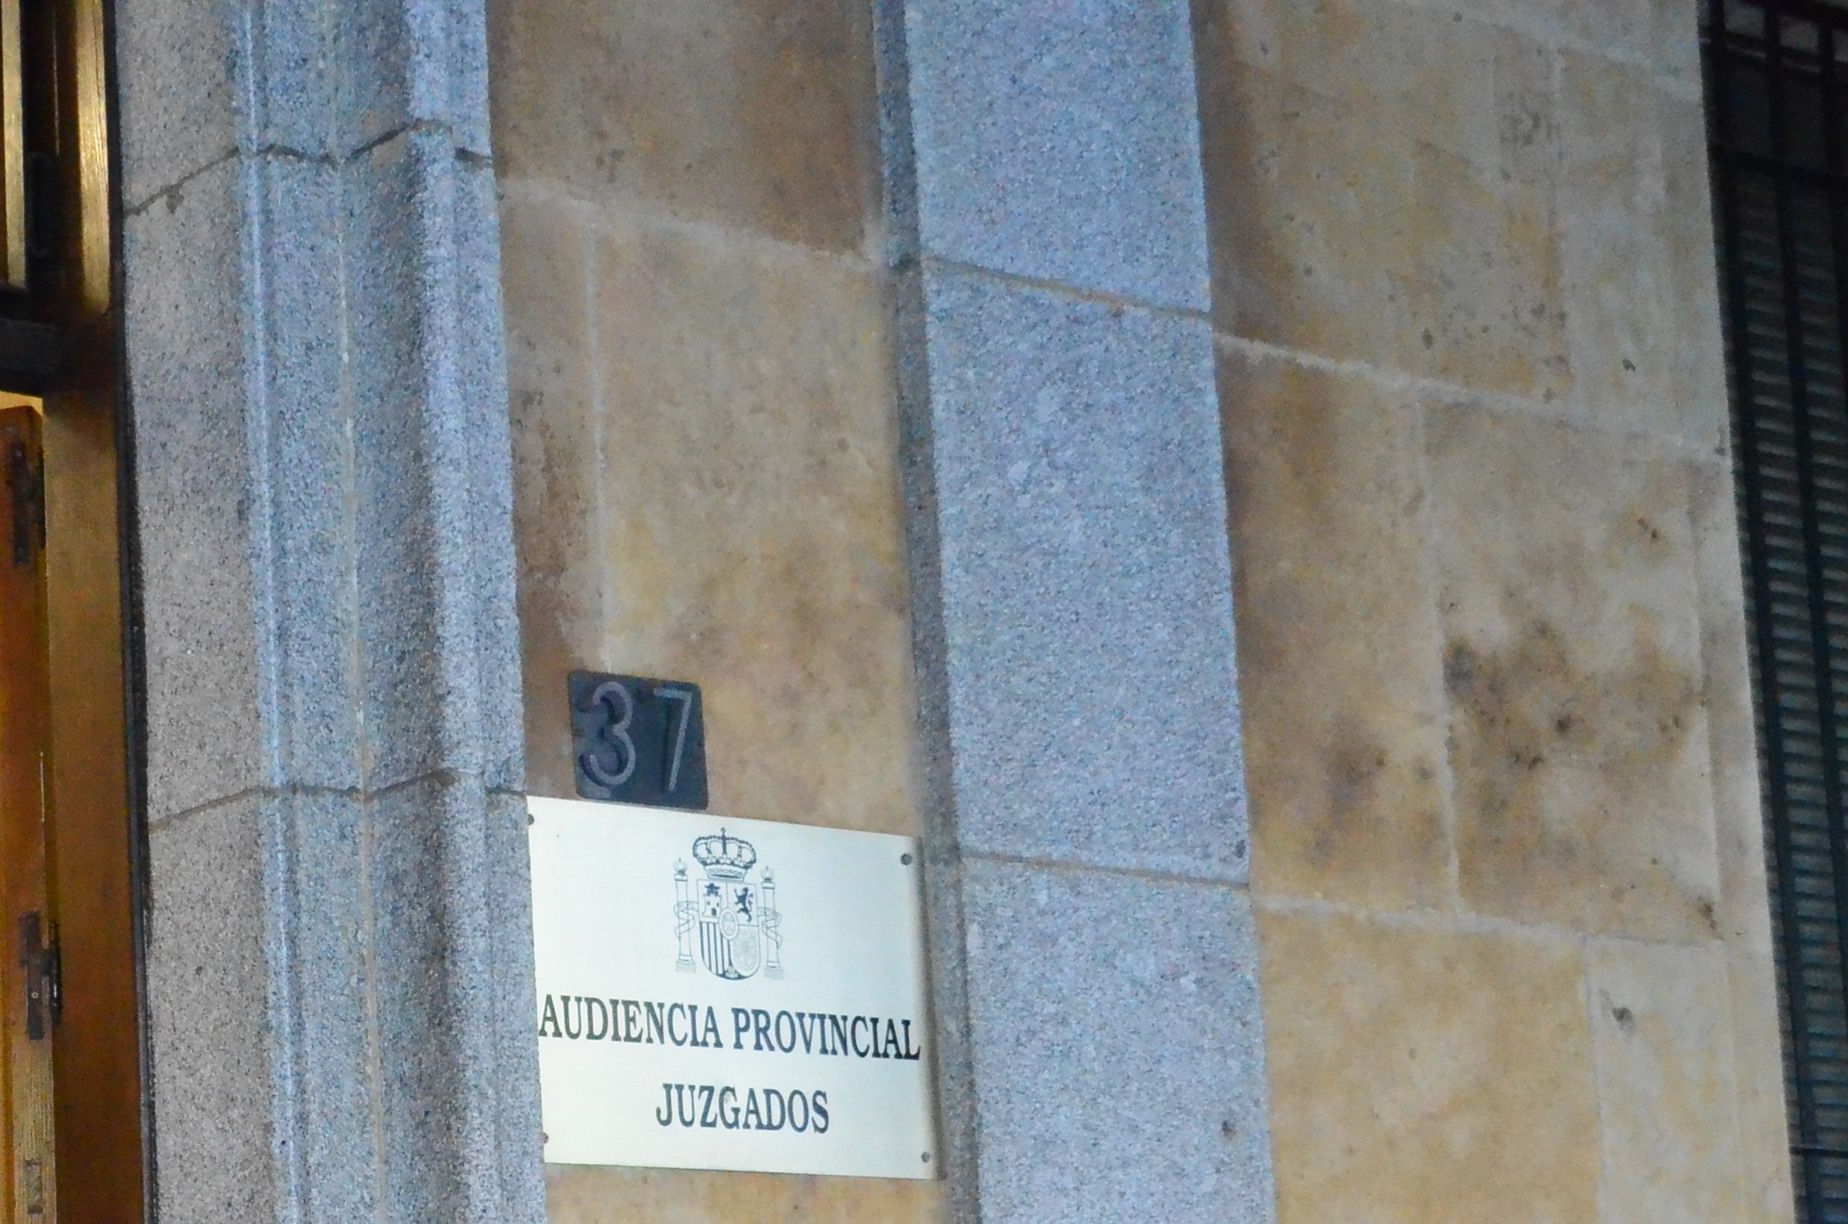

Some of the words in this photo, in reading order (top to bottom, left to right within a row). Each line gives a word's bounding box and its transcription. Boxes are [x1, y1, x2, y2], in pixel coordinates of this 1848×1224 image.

[586, 681, 692, 791] 37
[539, 993, 723, 1049] AUDIENCIA
[732, 1006, 921, 1061] PROVINCIAL
[656, 1082, 829, 1134] JUZGADOS
